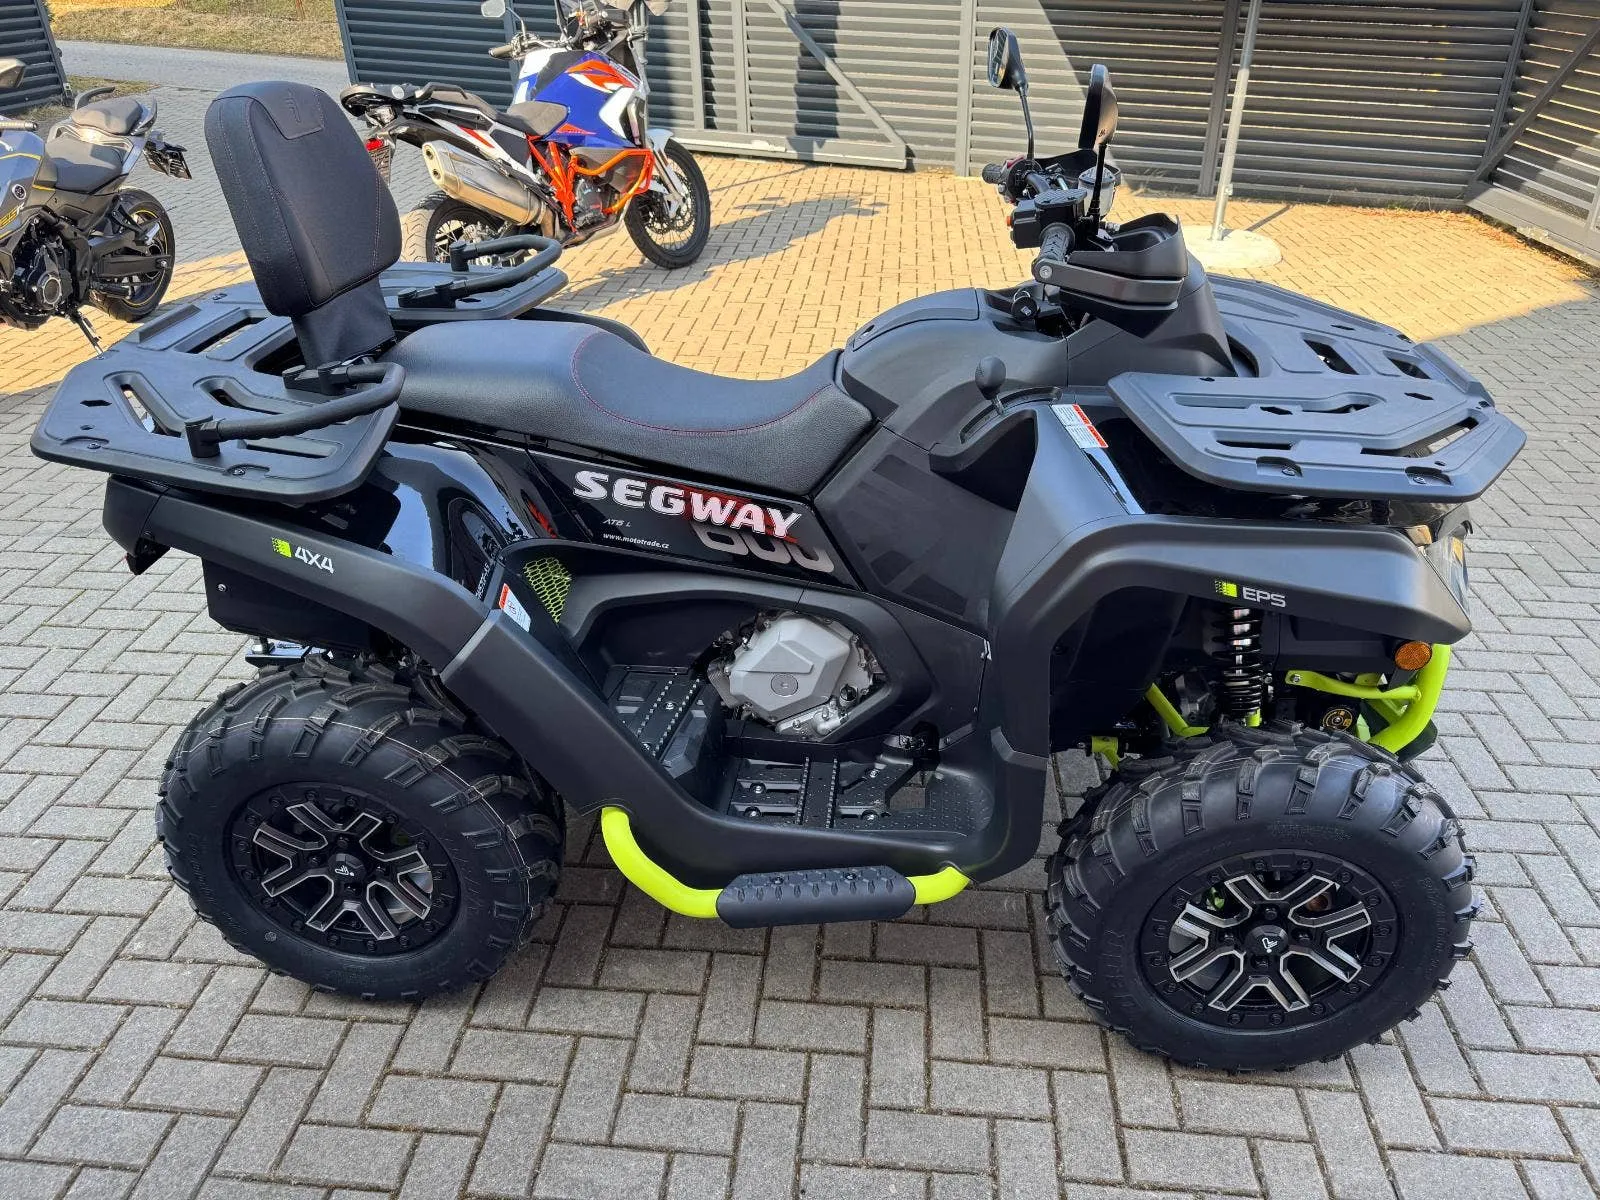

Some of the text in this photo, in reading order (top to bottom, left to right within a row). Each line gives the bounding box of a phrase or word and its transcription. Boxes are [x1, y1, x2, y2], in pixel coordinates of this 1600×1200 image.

[573, 470, 801, 538] SEGWAY
[603, 533, 670, 549] www.mototrade.cz
[1242, 586, 1286, 608] EPS
